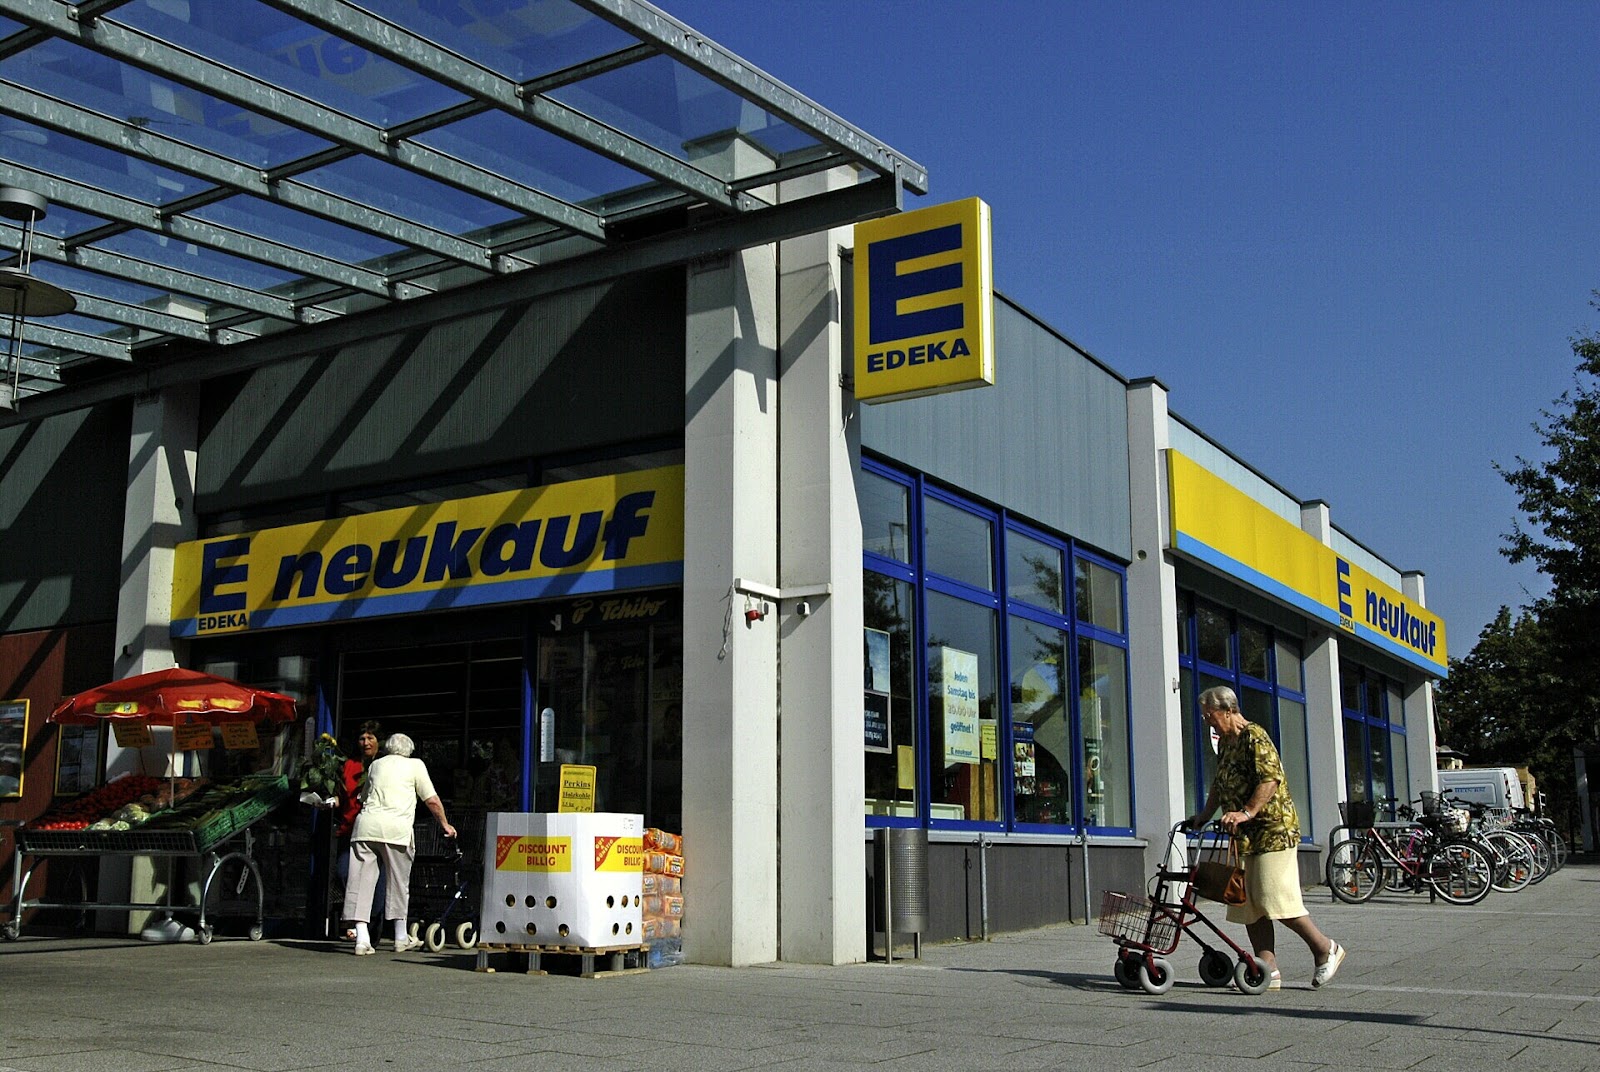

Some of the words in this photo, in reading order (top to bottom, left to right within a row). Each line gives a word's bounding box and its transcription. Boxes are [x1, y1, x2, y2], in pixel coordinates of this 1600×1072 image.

[868, 223, 964, 345] E
[867, 338, 971, 373] EDEKA
[200, 537, 250, 614] E
[272, 490, 656, 602] neukauf
[599, 597, 667, 622] Tchibo
[1336, 556, 1353, 618] E
[1366, 588, 1436, 657] neukauf
[198, 613, 248, 631] EDEKA
[954, 671, 968, 683] Jeden
[947, 685, 968, 701] Samstag
[968, 688, 976, 699] bis
[563, 791, 591, 799] Holzkohle
[518, 844, 567, 854] DISCOUNT
[526, 856, 556, 866] BILLIG
